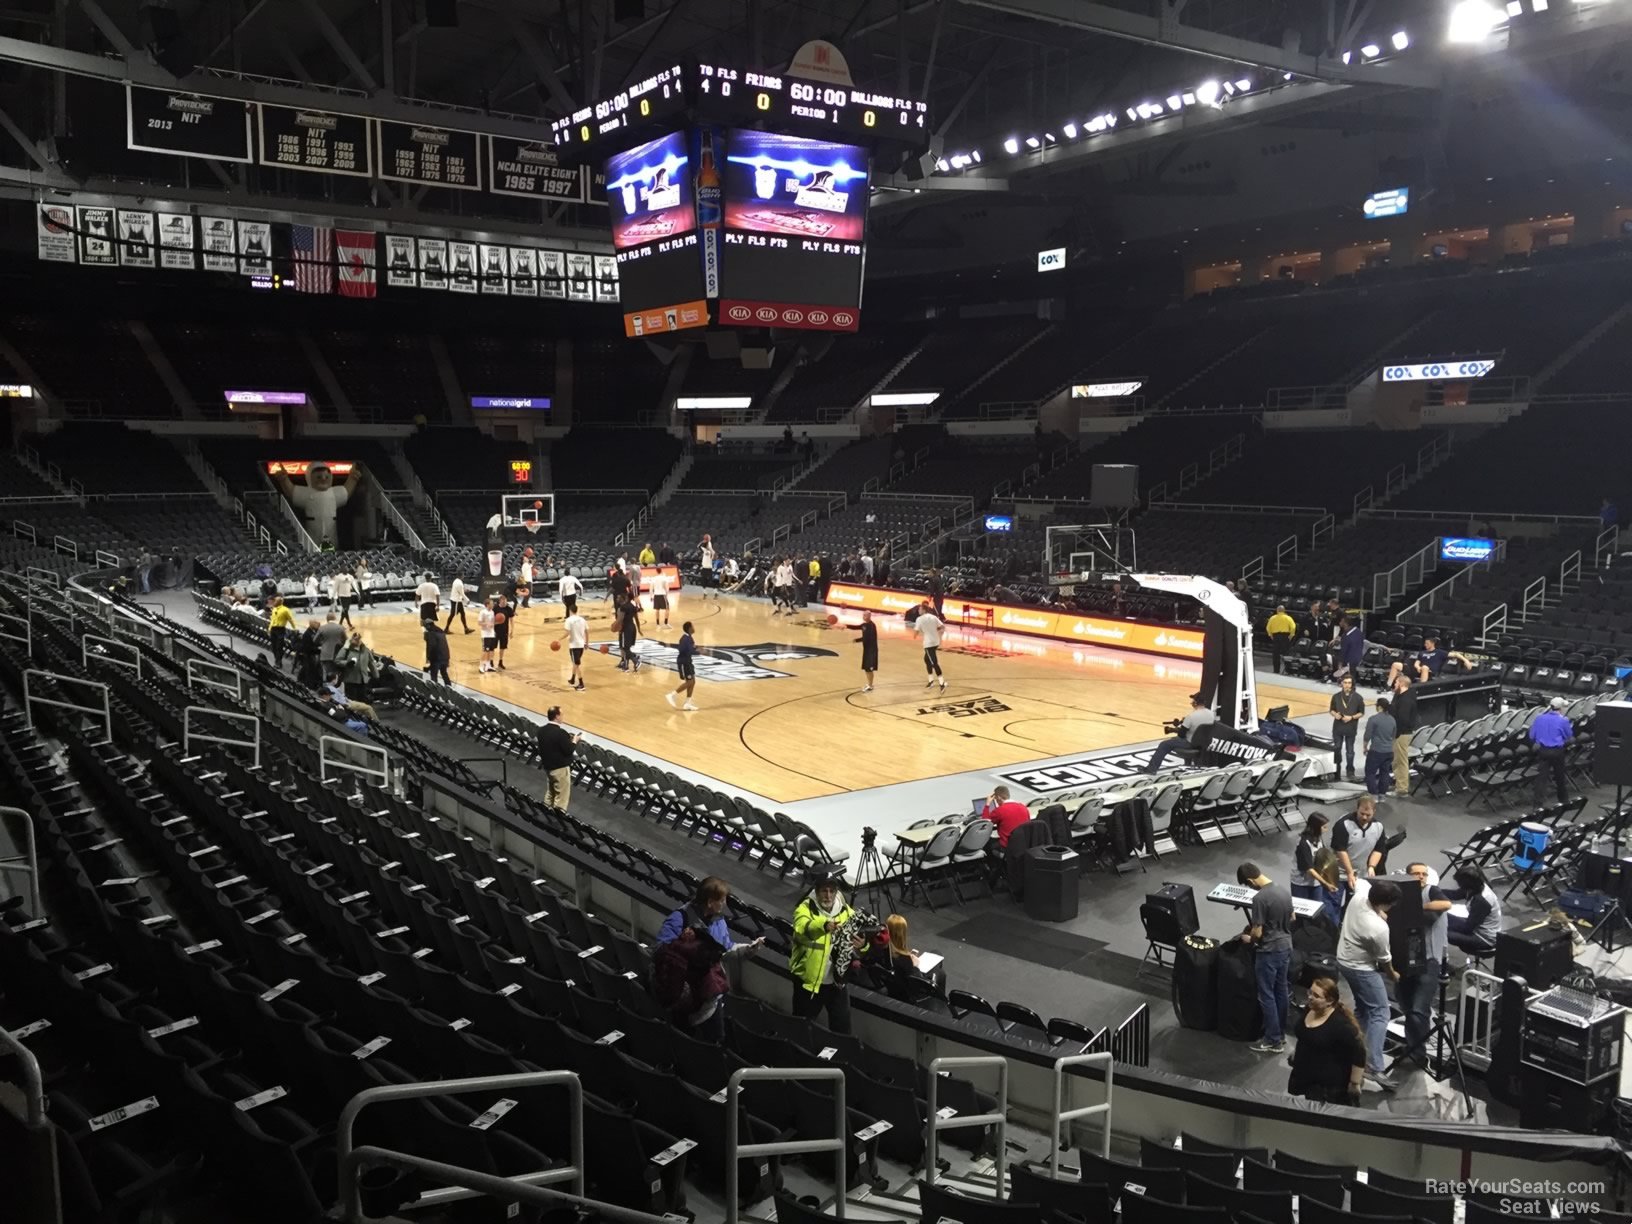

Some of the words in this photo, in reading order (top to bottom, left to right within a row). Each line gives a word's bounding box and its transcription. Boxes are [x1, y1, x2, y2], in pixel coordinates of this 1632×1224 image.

[700, 64, 713, 76] TO
[718, 67, 737, 80] FLS
[663, 84, 670, 98] 0
[701, 79, 710, 93] 4
[722, 82, 731, 96] 0
[757, 93, 769, 110] 0
[791, 84, 846, 106] 60:00
[596, 92, 629, 119] 60:00
[640, 99, 649, 116] 0
[896, 99, 912, 110] FLS
[181, 112, 202, 124] NIT
[792, 105, 825, 119] PERIOD
[863, 111, 875, 126] 0
[148, 119, 173, 130] 2013
[900, 112, 907, 125] 0
[916, 114, 924, 127] 4
[308, 128, 326, 138] NIT
[581, 126, 589, 141] 0
[279, 144, 299, 154] 1995
[306, 138, 325, 148] 1991
[334, 142, 354, 151] 1993
[422, 143, 439, 153] NIT
[278, 153, 300, 162] 2003
[306, 156, 328, 166] 2007
[334, 160, 355, 169] 2009
[396, 167, 414, 176] 1971
[497, 161, 521, 173] NCAA
[524, 165, 549, 176] ELITE
[551, 168, 578, 179] EIGHT
[504, 175, 535, 190] 1965
[543, 180, 572, 194] 1997
[92, 242, 104, 250] 24
[672, 239, 683, 249] FLS
[726, 234, 744, 244] PLY
[748, 236, 766, 246] FLS
[770, 238, 788, 248] PTS
[803, 241, 820, 251] PLY
[824, 243, 840, 253] FLS
[844, 245, 860, 255] PTS
[1041, 254, 1059, 265] COX
[1386, 367, 1413, 379] COX
[1422, 365, 1450, 377] COX
[489, 399, 532, 408] nationalgrid
[516, 470, 528, 481] 30
[1011, 614, 1048, 628] Santander
[1084, 624, 1126, 639] Santander
